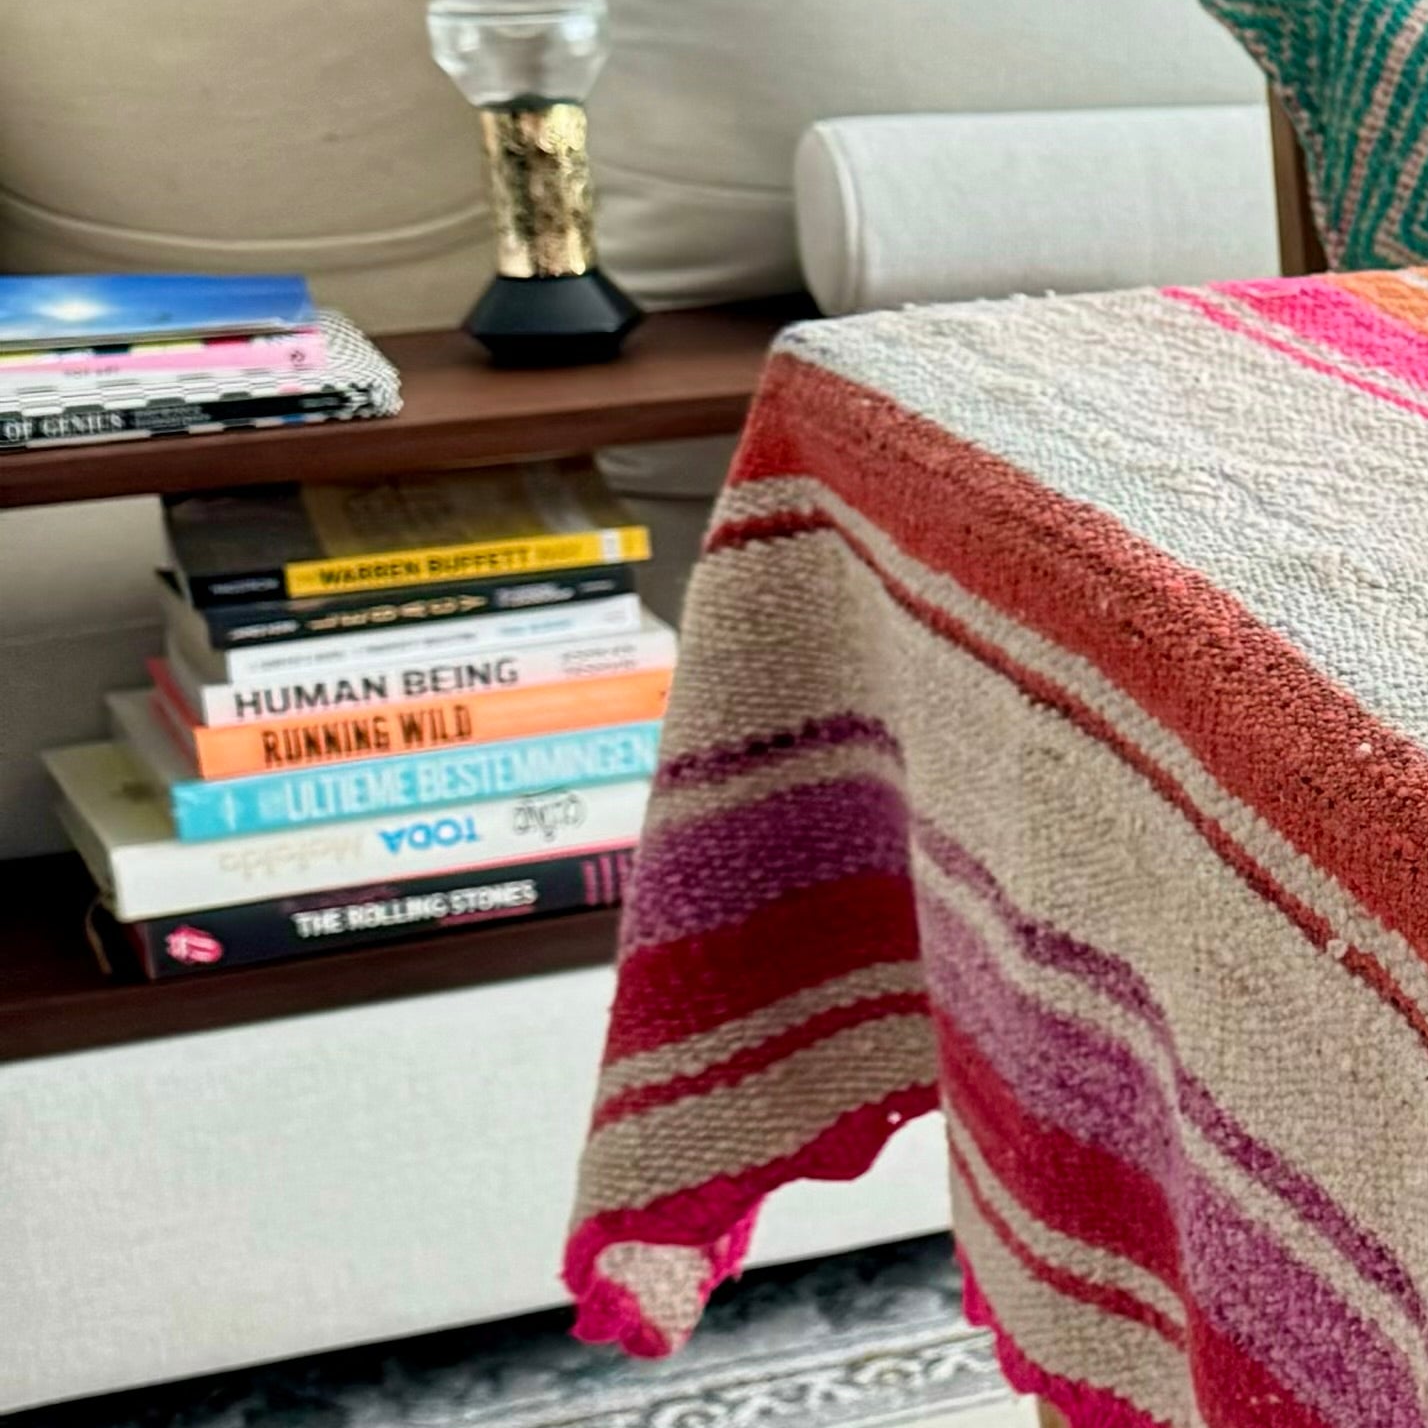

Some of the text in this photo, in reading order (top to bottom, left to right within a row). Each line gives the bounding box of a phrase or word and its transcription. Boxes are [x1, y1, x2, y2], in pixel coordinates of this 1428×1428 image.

[319, 557, 420, 586] WARREN
[426, 548, 530, 576] BUFFETT
[234, 674, 388, 718] HUMAN
[403, 656, 519, 697] BEING
[261, 703, 473, 767] RUNNING WILD
[283, 732, 657, 821] ULTIEME BESTEMMINGEN
[378, 814, 480, 854] TODA
[293, 878, 539, 938] THE ROLLING STONES
